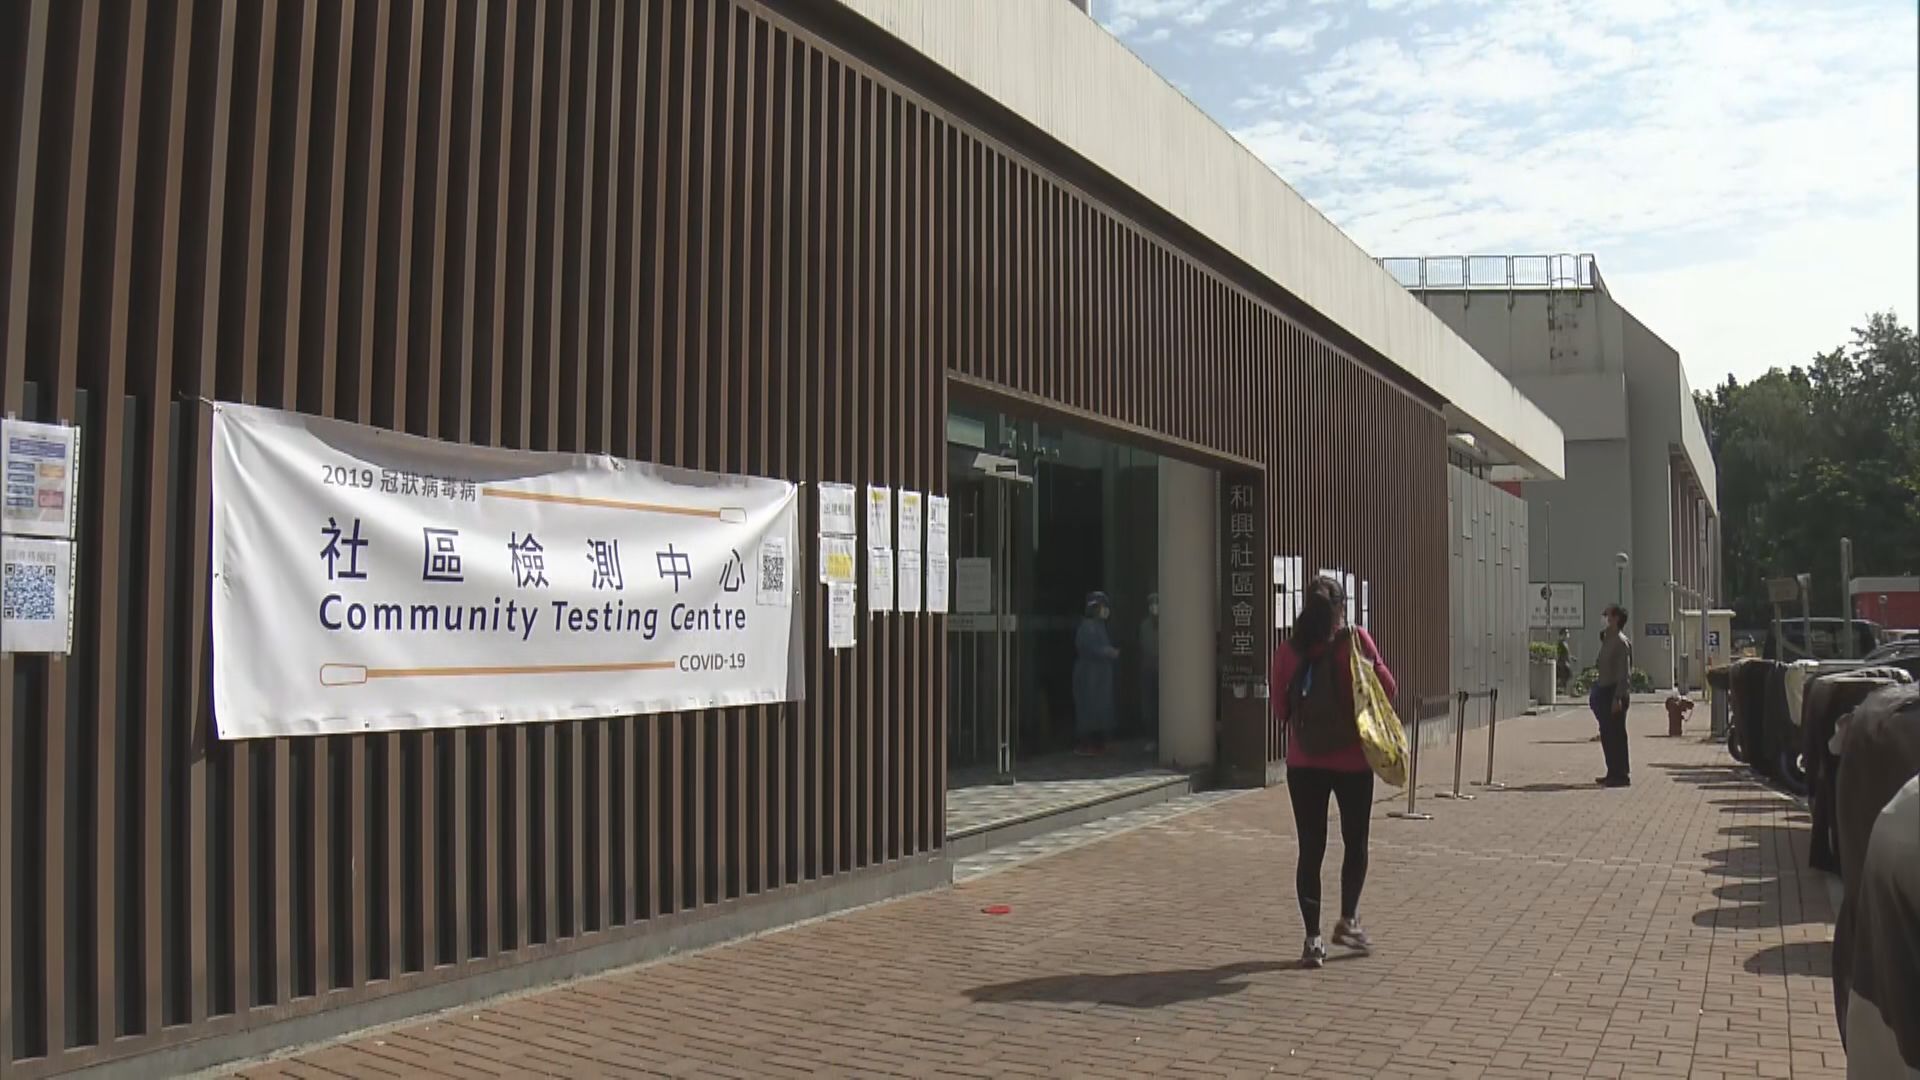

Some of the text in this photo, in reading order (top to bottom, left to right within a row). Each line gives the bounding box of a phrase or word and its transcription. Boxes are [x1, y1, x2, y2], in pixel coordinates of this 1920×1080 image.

[322, 465, 477, 502] 2019 冠狀病毒病
[320, 517, 746, 594] 社區檢測中心
[1230, 484, 1255, 655] 和興社區會堂
[319, 594, 747, 641] Community Testing Centre
[679, 653, 746, 672] COVID-19
